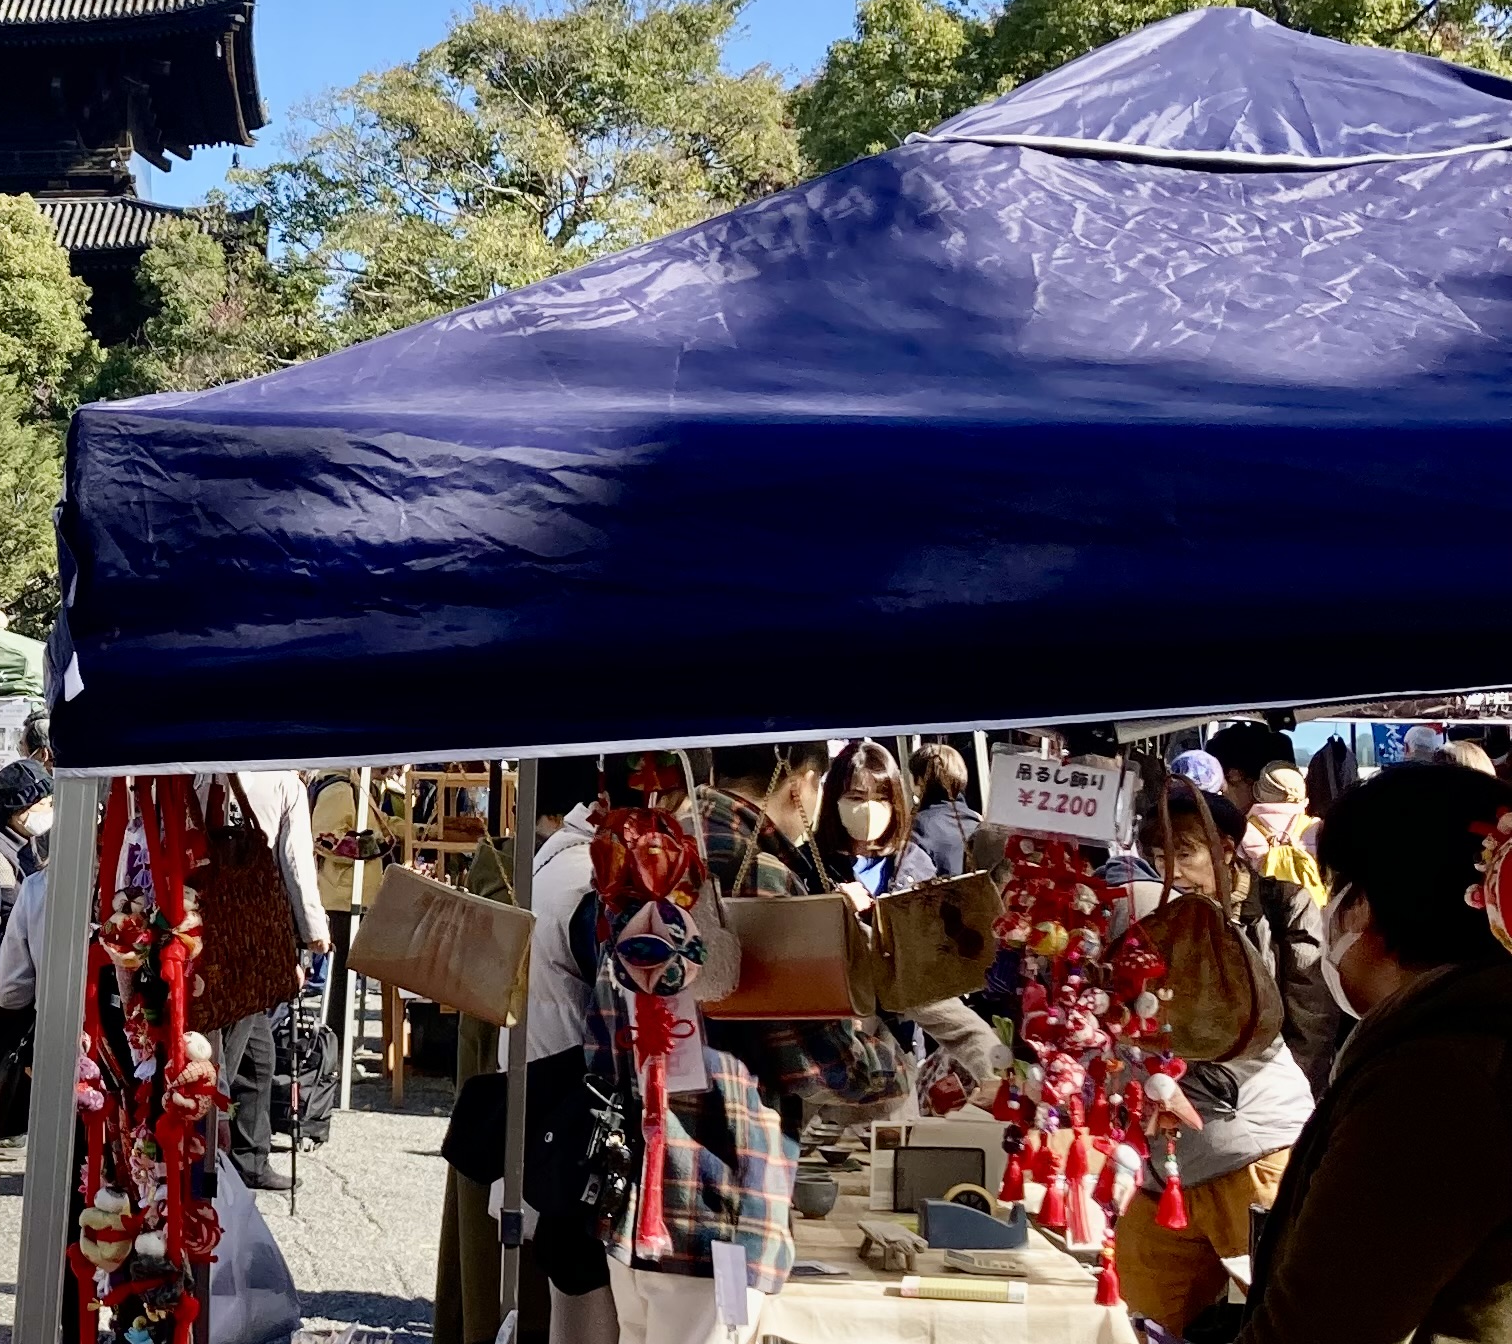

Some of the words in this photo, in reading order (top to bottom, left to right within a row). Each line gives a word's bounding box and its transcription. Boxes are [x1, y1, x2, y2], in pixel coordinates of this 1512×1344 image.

[1016, 763, 1104, 791] 吊るし飾り
